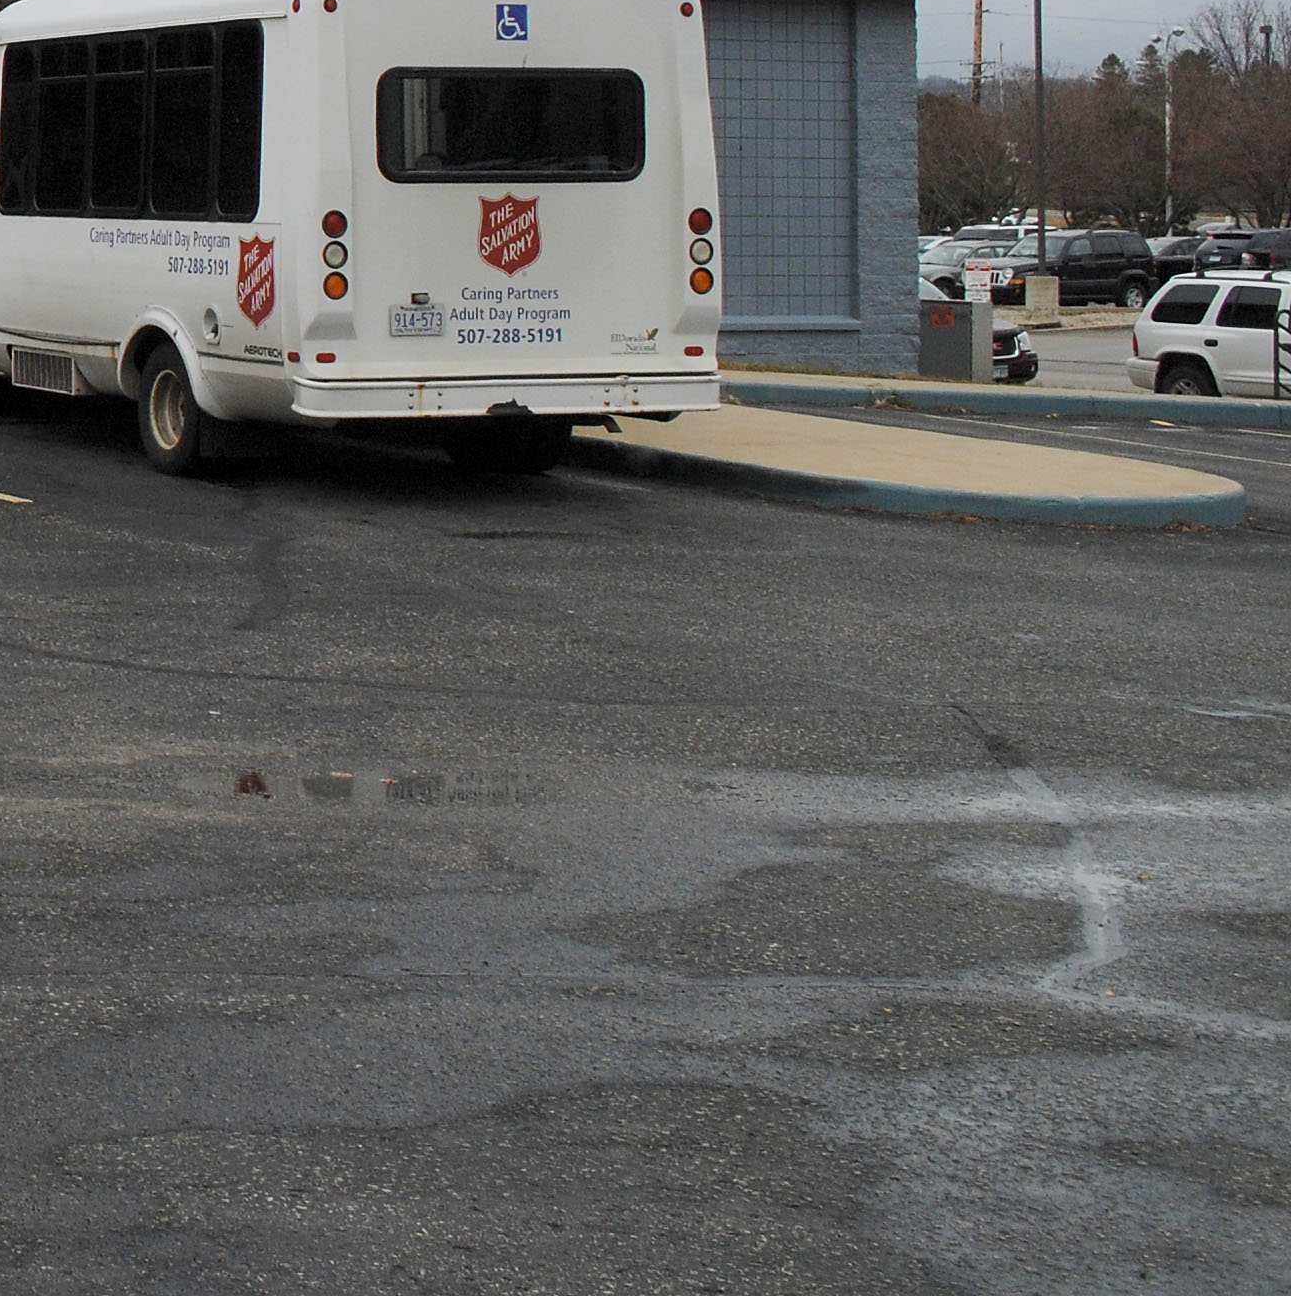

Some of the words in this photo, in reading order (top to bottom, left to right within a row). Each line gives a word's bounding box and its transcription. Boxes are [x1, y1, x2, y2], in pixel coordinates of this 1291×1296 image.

[489, 202, 515, 228] THE
[90, 227, 114, 247] Caring
[116, 228, 148, 245] Partners
[150, 229, 173, 246] Adult
[174, 230, 190, 251] Day
[193, 231, 230, 253] Program
[481, 205, 535, 256] SALVATION
[243, 244, 260, 273] THE
[501, 228, 534, 265] ARMY
[167, 256, 229, 276] 507-288-5191
[238, 248, 273, 304] SALVATION
[250, 274, 272, 315] ARMY
[461, 286, 503, 304] Caring
[507, 287, 559, 300] Partners
[394, 311, 443, 328] 914-573
[449, 306, 484, 321] Adult
[489, 307, 513, 324] Day
[517, 306, 571, 323] Program
[457, 327, 562, 344] 507-288-5191
[244, 345, 283, 358] AEROTECH
